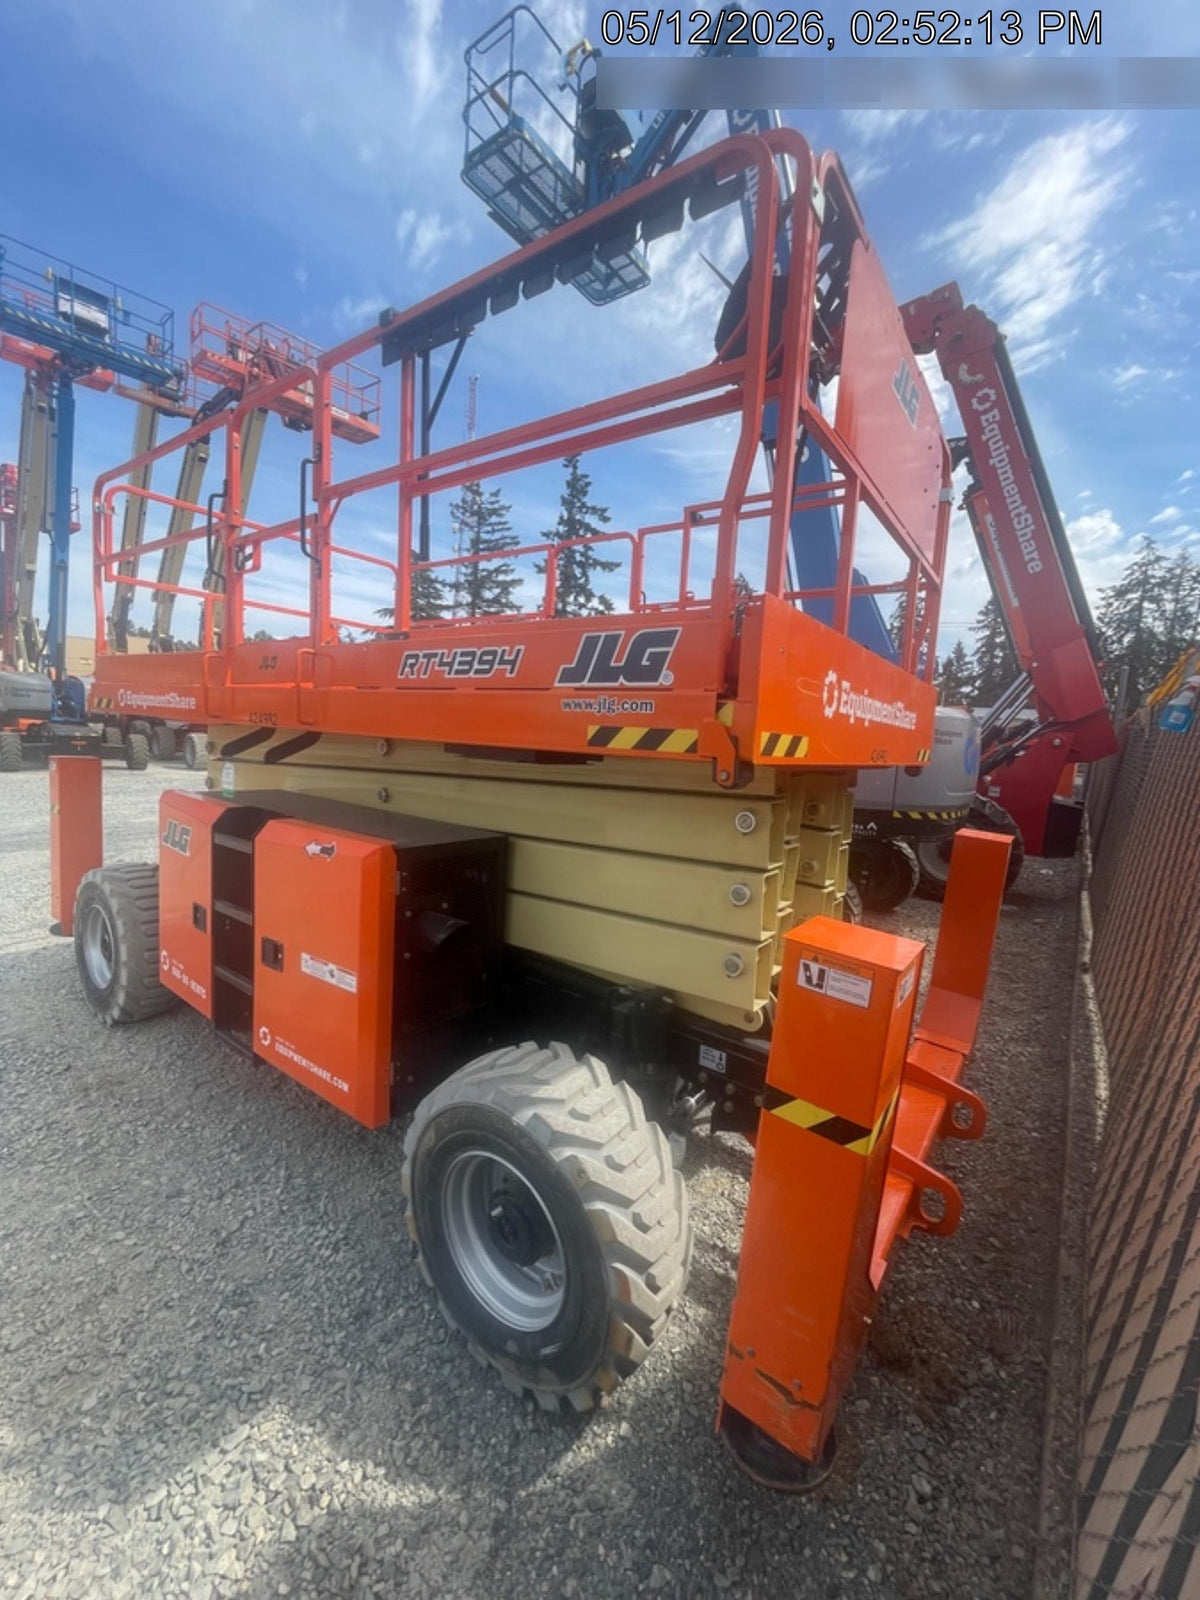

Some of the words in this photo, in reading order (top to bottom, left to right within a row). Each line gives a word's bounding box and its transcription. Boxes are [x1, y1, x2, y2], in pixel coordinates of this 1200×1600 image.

[892, 359, 921, 431] JLG
[980, 407, 1043, 575] EquipmentShare
[397, 645, 525, 678] RT4394
[554, 627, 682, 687] JLG
[125, 690, 197, 710] EquipmentShare
[562, 696, 654, 713] www.jlg.com
[838, 680, 917, 730] EquipmentShare
[161, 818, 192, 858] JLG
[275, 1041, 350, 1093] EQUIPMENTSHARE.COM
